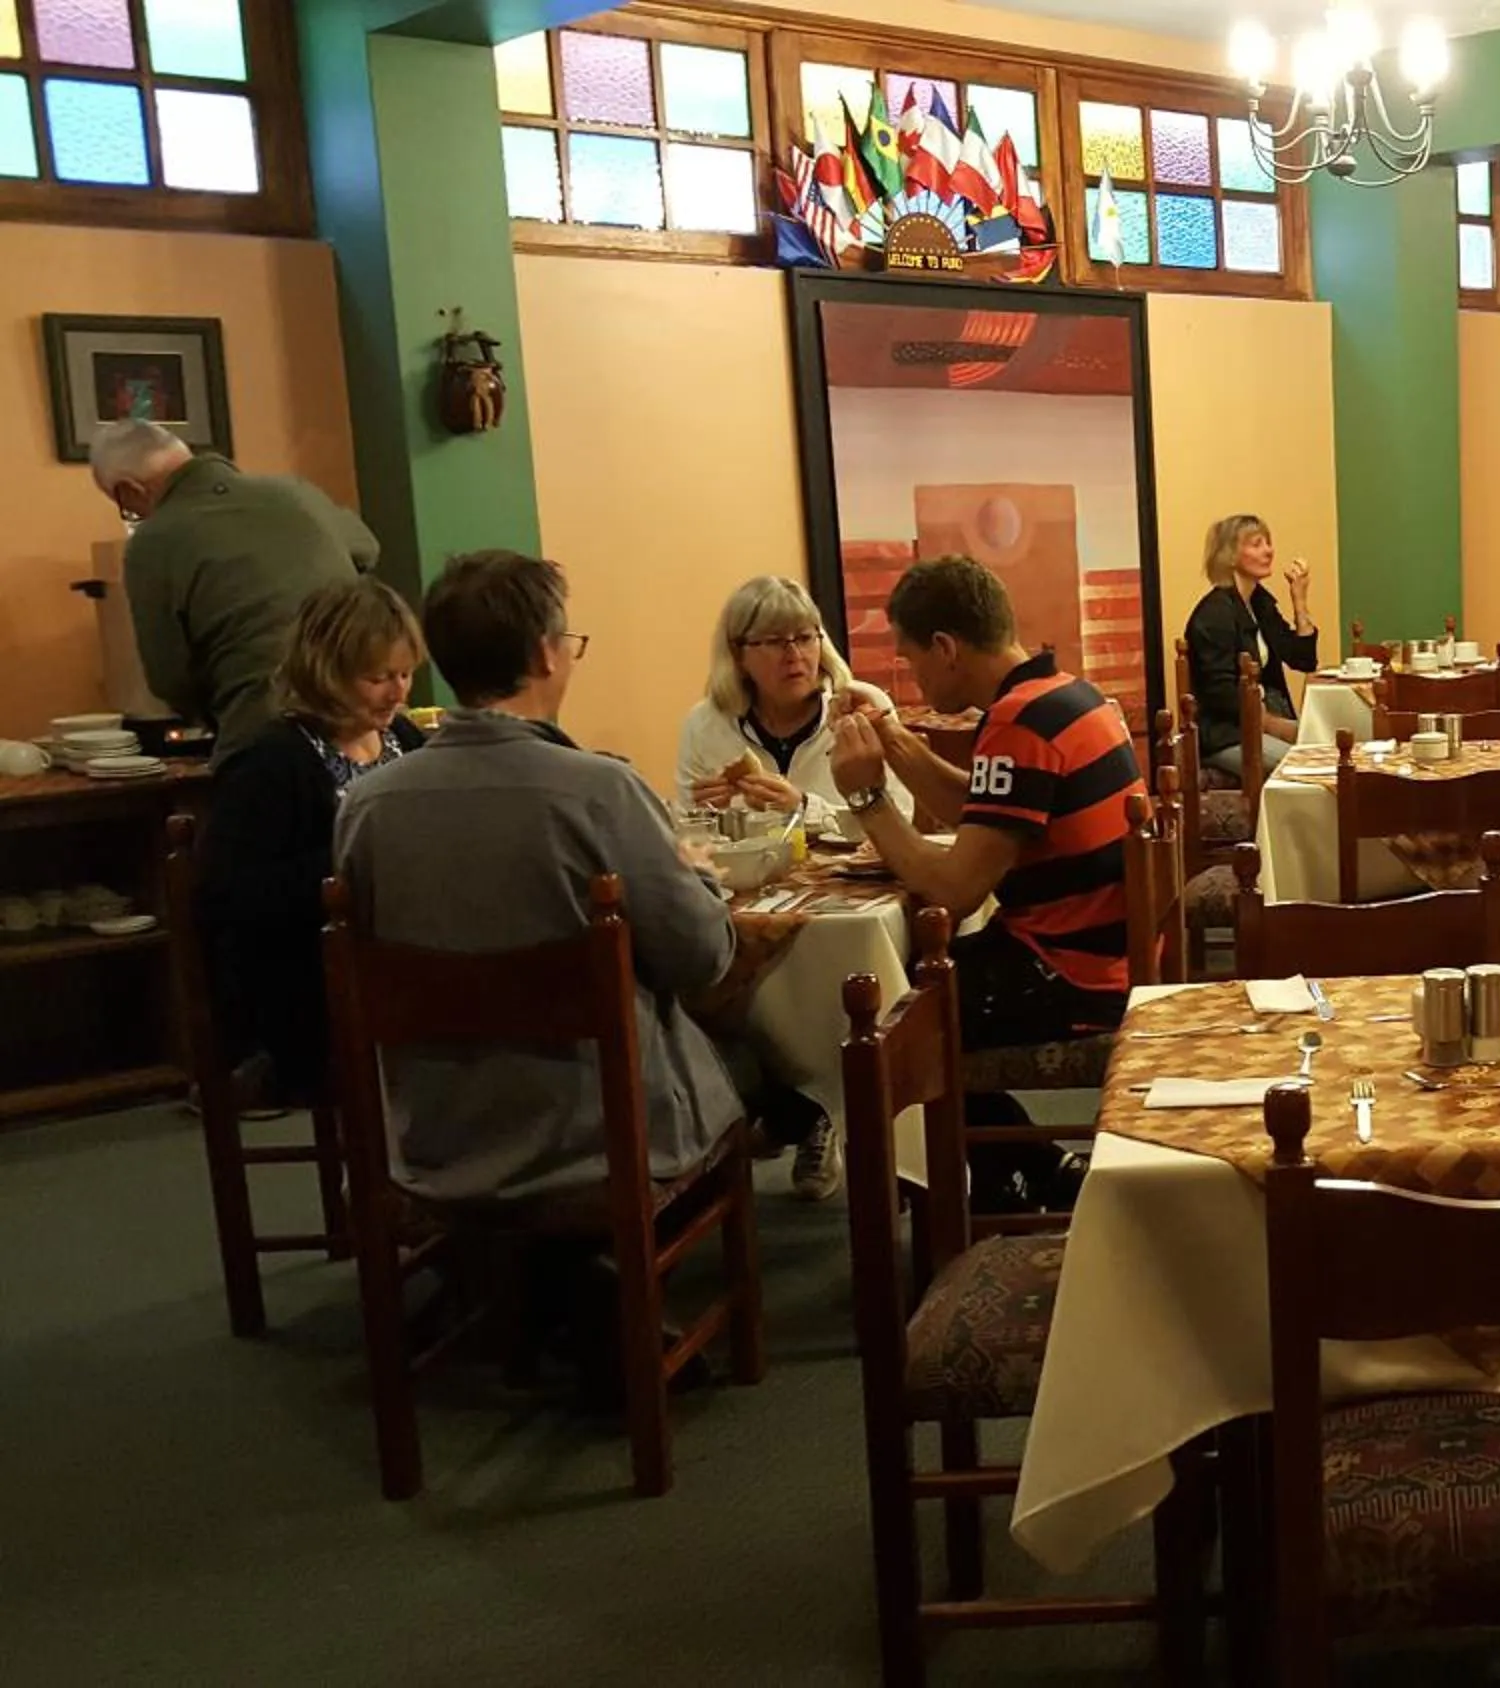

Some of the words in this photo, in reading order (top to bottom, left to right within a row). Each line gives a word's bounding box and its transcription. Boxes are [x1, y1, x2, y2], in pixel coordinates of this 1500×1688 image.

[888, 253, 923, 268] WELCOME
[926, 255, 939, 269] TO
[970, 755, 1015, 795] 86
